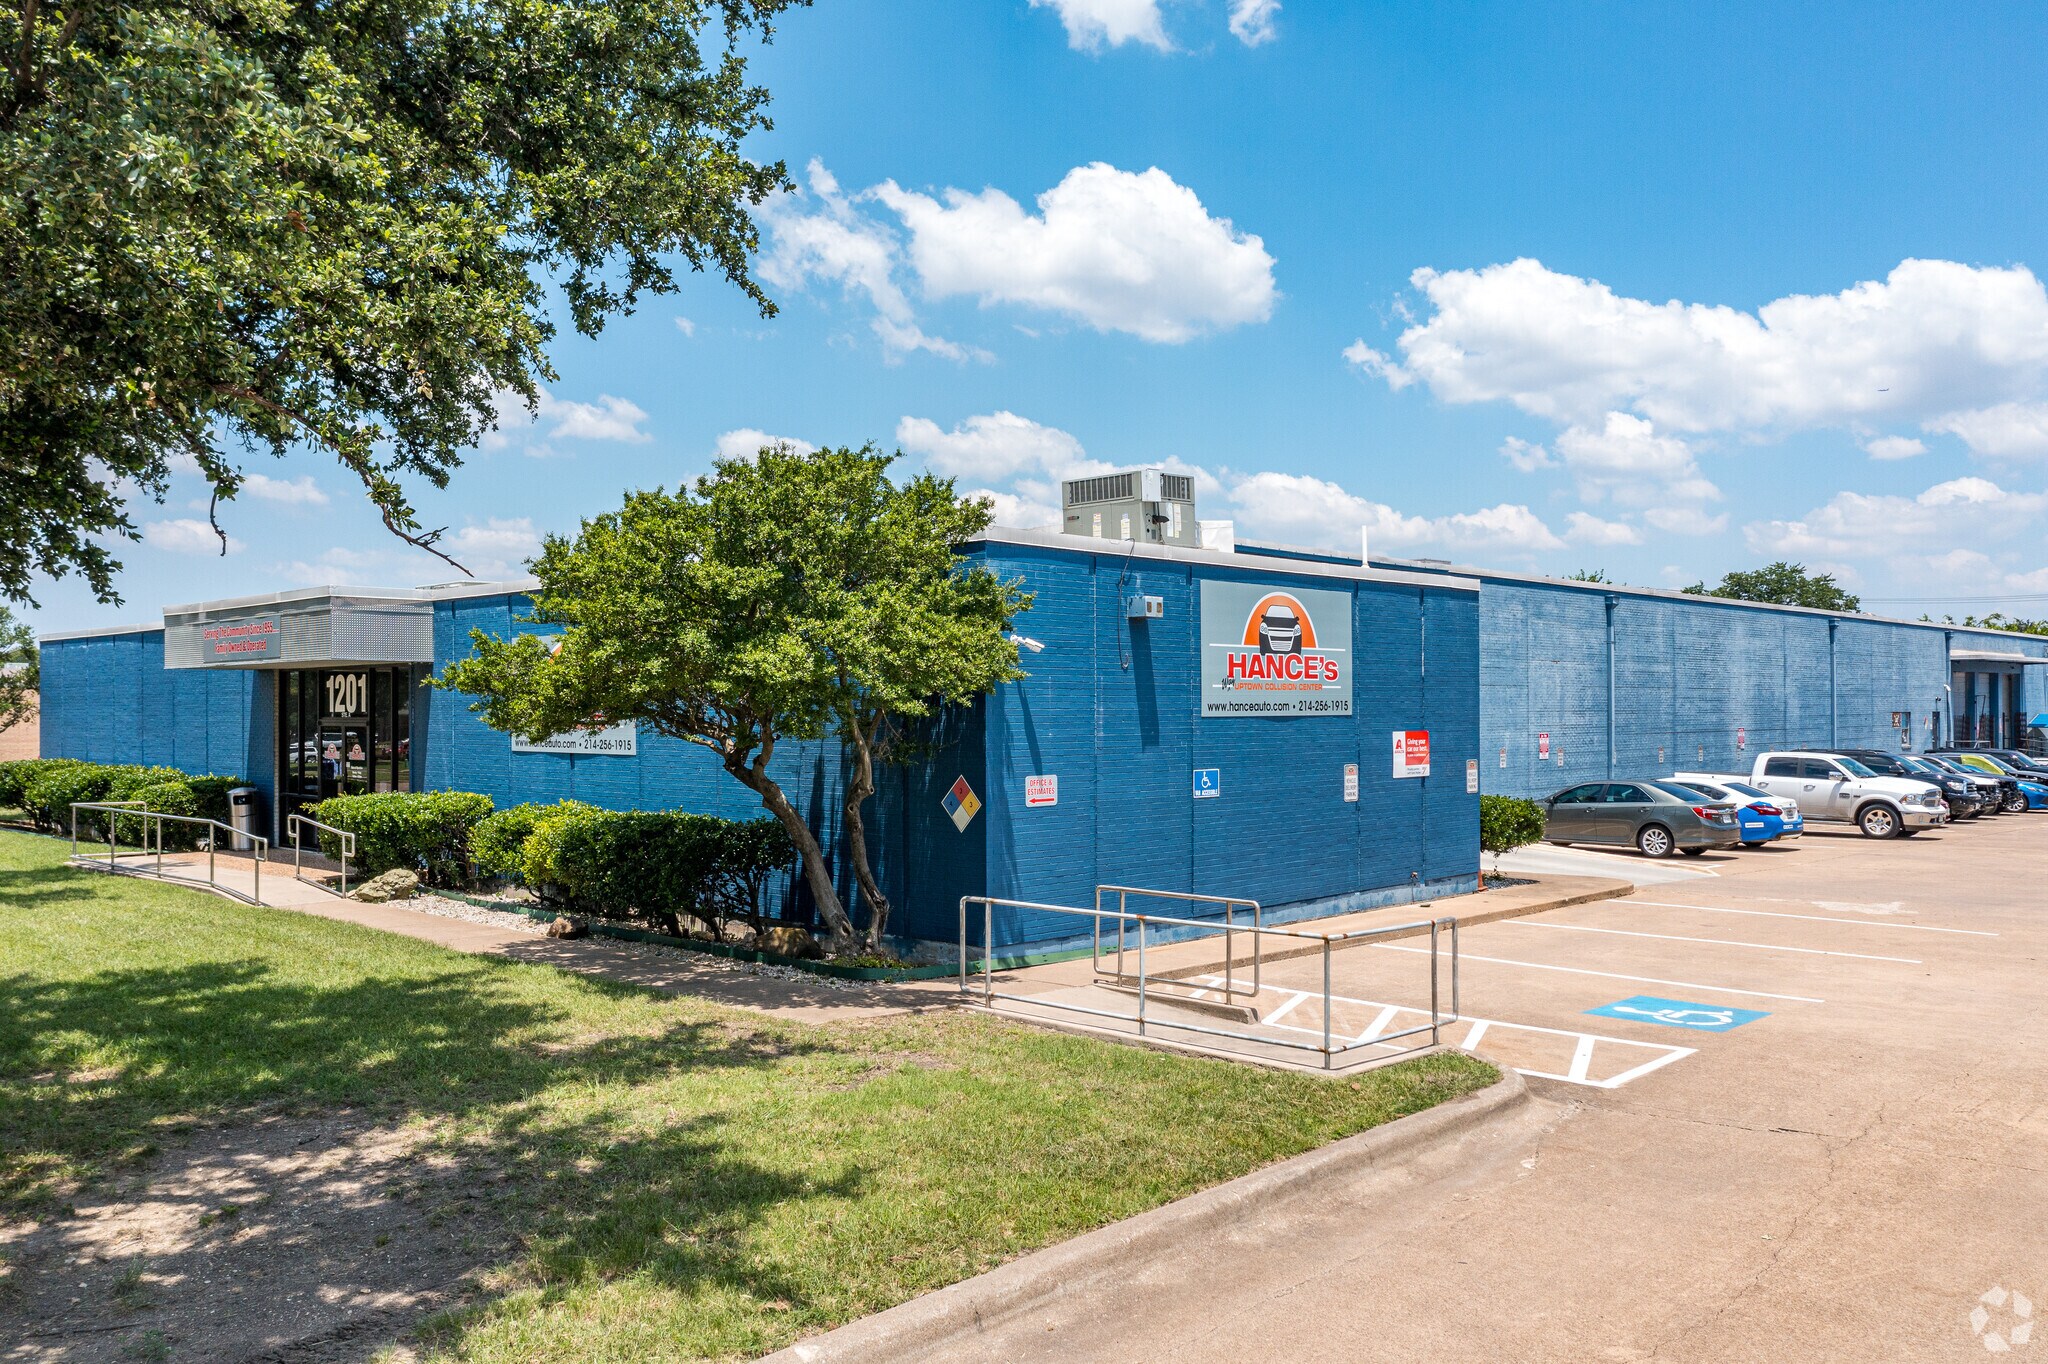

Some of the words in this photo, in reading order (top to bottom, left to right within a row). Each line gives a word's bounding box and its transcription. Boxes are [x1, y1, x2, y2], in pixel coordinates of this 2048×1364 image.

[204, 628, 219, 640] Serving
[219, 626, 227, 637] The
[227, 624, 249, 638] Community
[249, 623, 262, 635] Since
[228, 641, 242, 653] Owned
[247, 638, 267, 654] Operated
[1234, 682, 1263, 691] UPTOWN
[1265, 683, 1297, 691] COLLISION
[1299, 683, 1323, 691] CENTER
[326, 674, 366, 713] 1201
[1207, 701, 1290, 712] www.hanceauto.com
[1299, 700, 1349, 712] 214-256-1915
[584, 739, 632, 751] 214-256-1915
[1027, 787, 1055, 796] ESTIMATES
